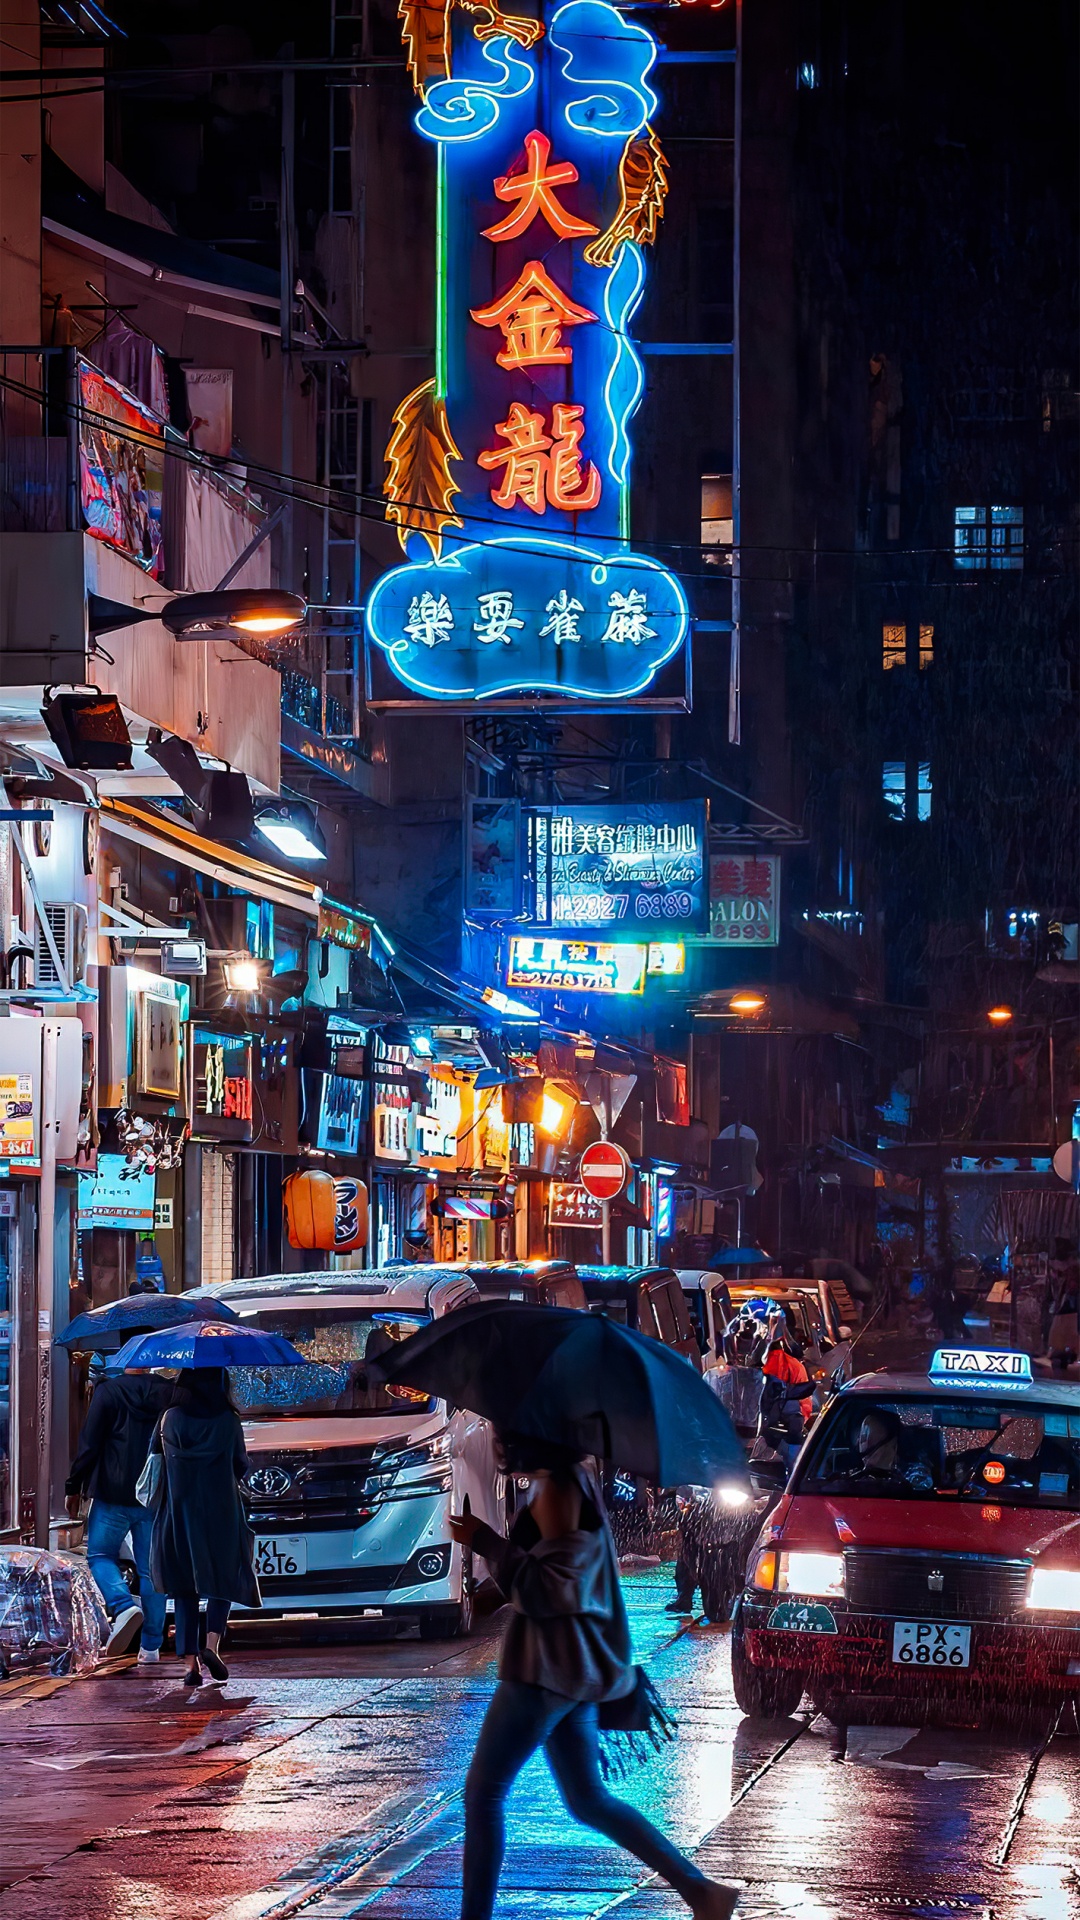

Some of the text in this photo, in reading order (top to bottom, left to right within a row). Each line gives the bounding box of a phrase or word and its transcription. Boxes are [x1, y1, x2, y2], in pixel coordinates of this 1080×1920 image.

[469, 129, 601, 514] 大金龍
[634, 892, 693, 919] 6889
[940, 1352, 1021, 1374] TAXI
[258, 1540, 286, 1558] KL
[796, 1608, 809, 1622] 4
[916, 1624, 950, 1646] PX
[898, 1642, 964, 1666] 6866
